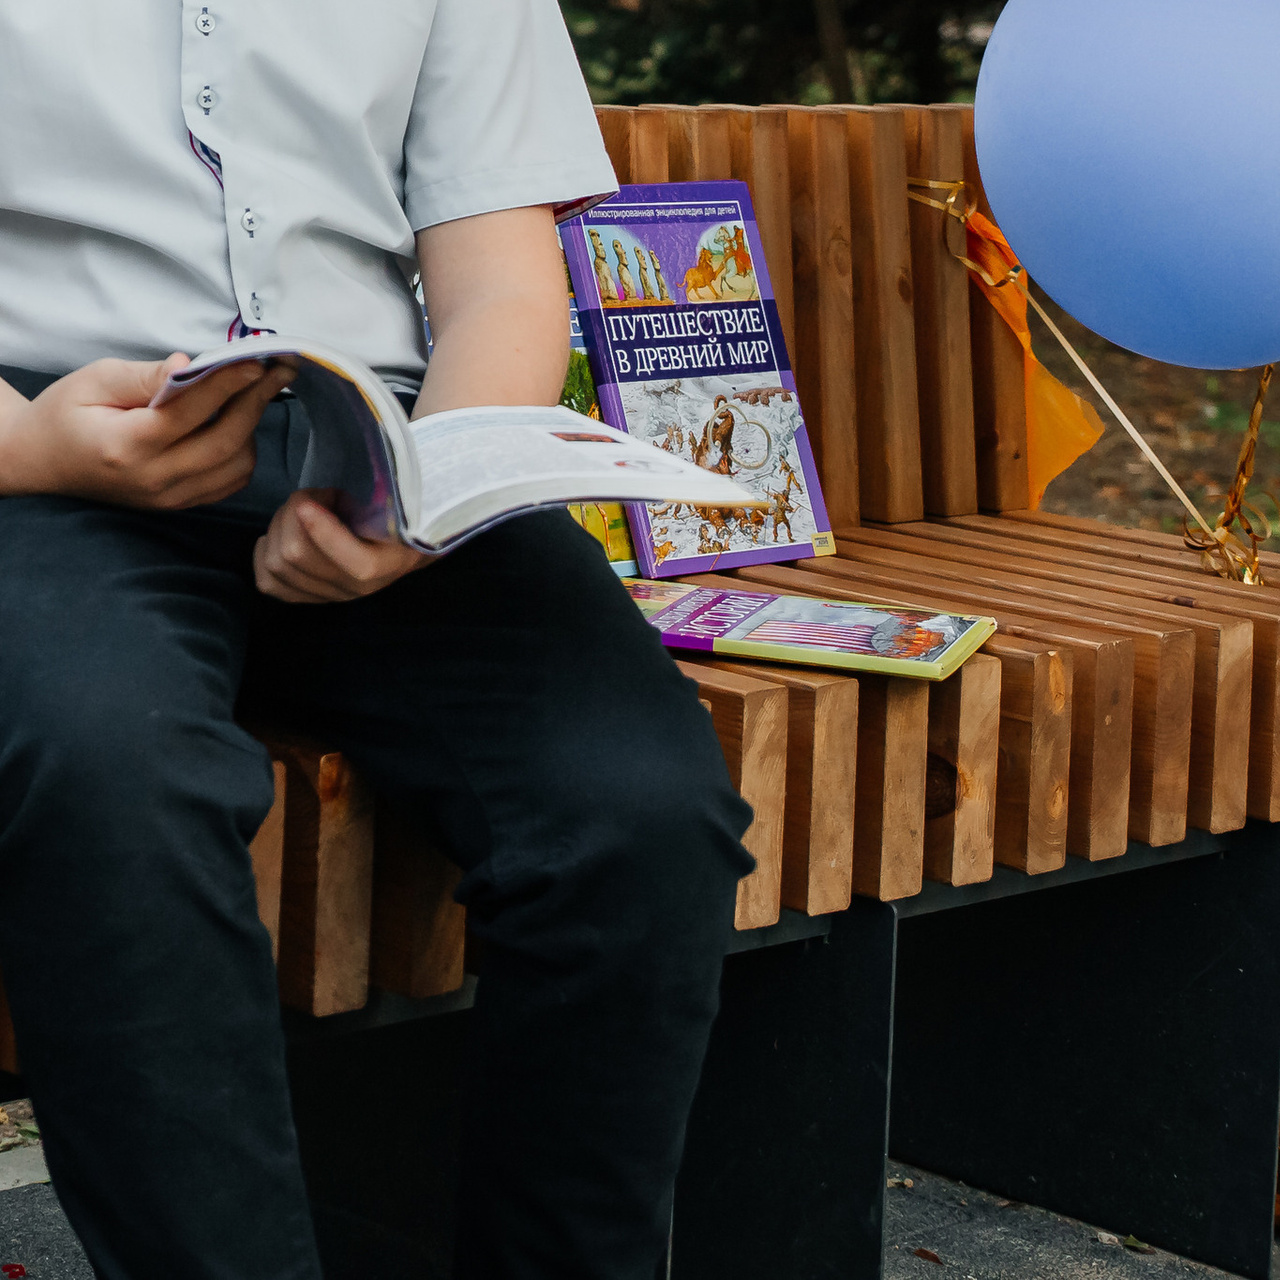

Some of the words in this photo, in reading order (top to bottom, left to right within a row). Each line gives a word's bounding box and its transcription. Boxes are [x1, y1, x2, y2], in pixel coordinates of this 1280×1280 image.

[587, 208, 654, 220] Иллюстрированная
[655, 207, 703, 218] энциклопедия
[704, 206, 716, 216] для
[717, 204, 736, 216] детей
[608, 308, 764, 342] ПУТЕШЕСТВИЕ
[615, 349, 631, 374] В
[634, 337, 726, 376] ДРЕВНИЙ
[727, 340, 769, 365] МИР
[678, 595, 769, 636] ИСТОРИИ
